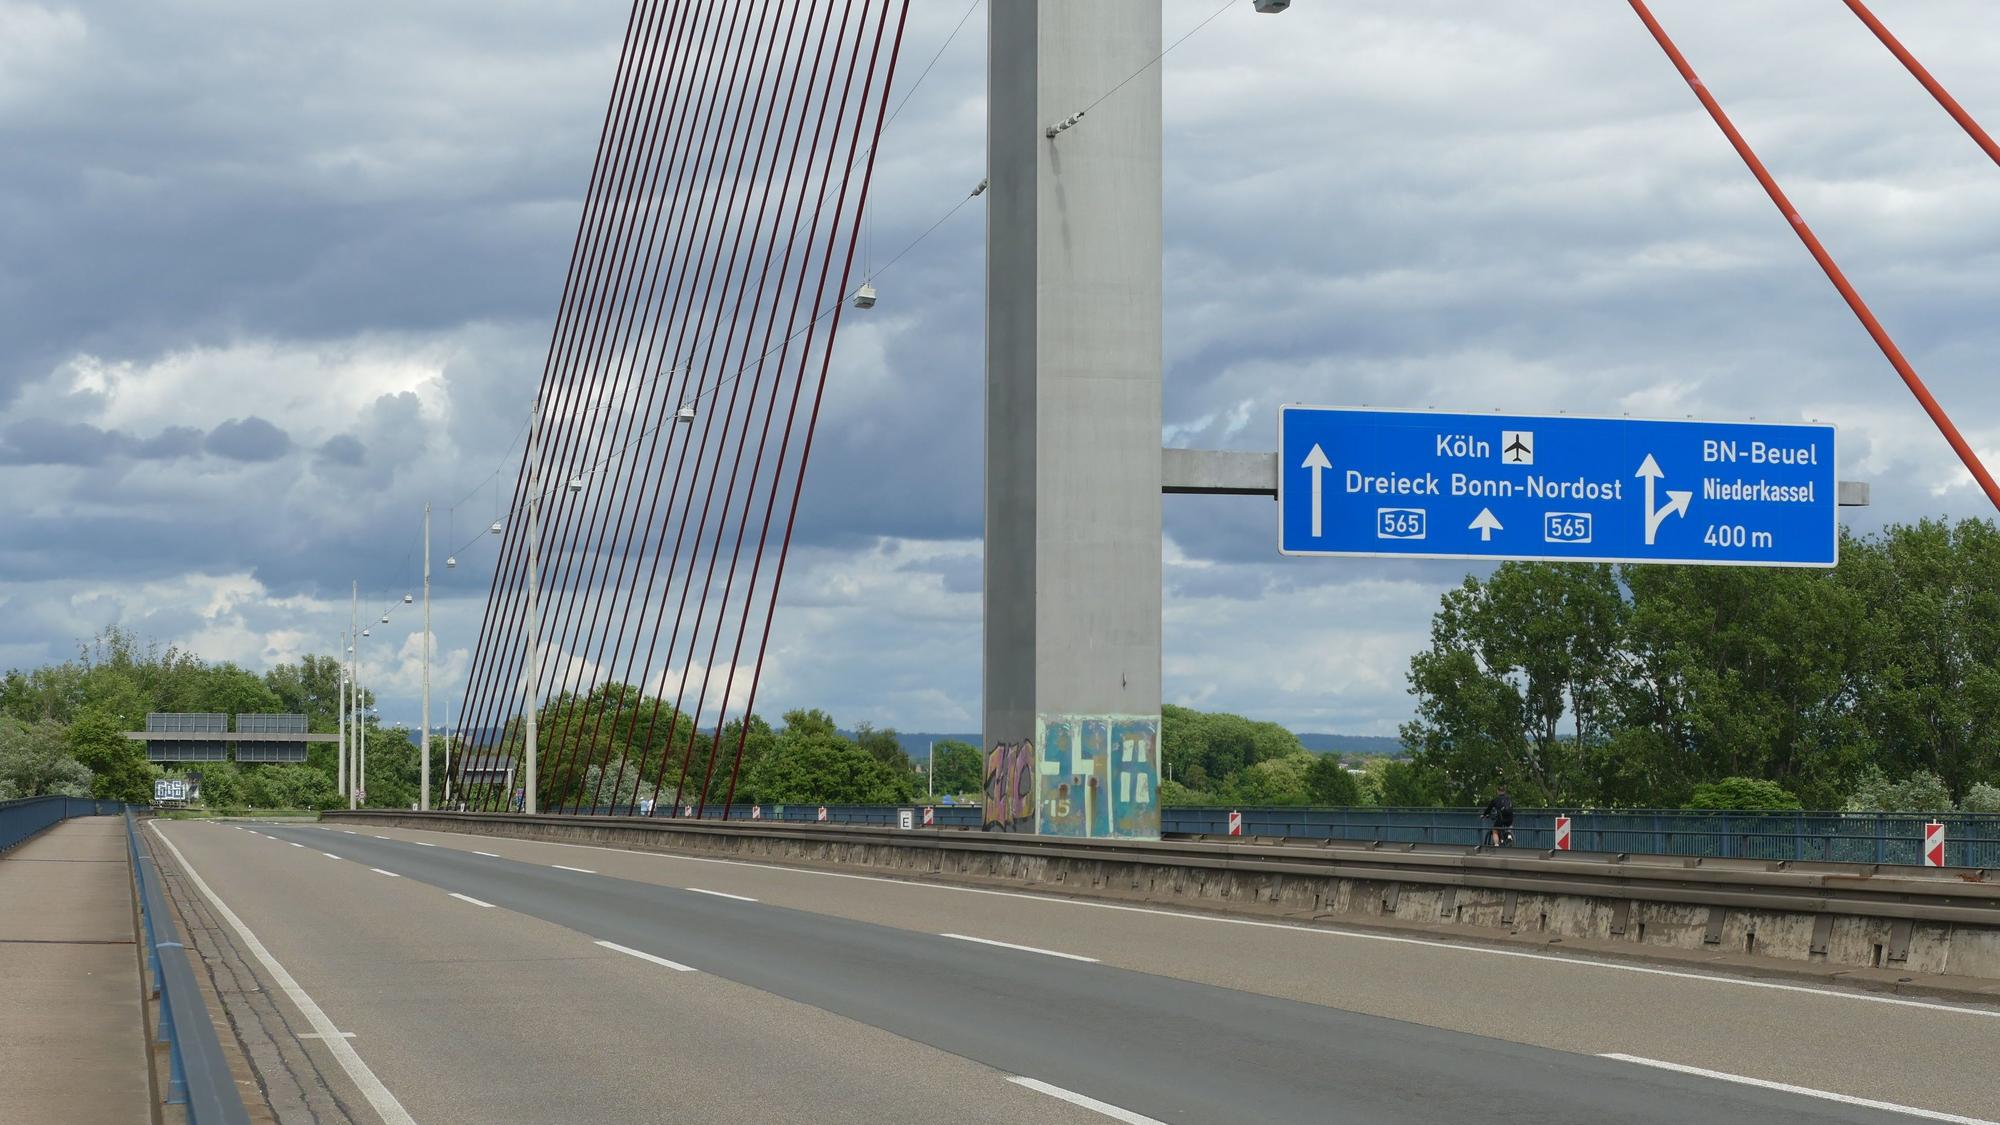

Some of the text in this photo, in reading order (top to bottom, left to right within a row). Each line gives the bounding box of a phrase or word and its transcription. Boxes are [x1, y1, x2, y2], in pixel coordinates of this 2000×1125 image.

[1436, 434, 1490, 458] Köln
[1703, 440, 1818, 465] BN-Beuel
[1346, 470, 1622, 500] Dreieck Bonn-Nordost
[1703, 477, 1815, 502] Niederkassel
[1384, 514, 1420, 534] 565
[1551, 518, 1586, 537] 565
[1704, 524, 1772, 548] 400 m
[902, 817, 910, 828] E
